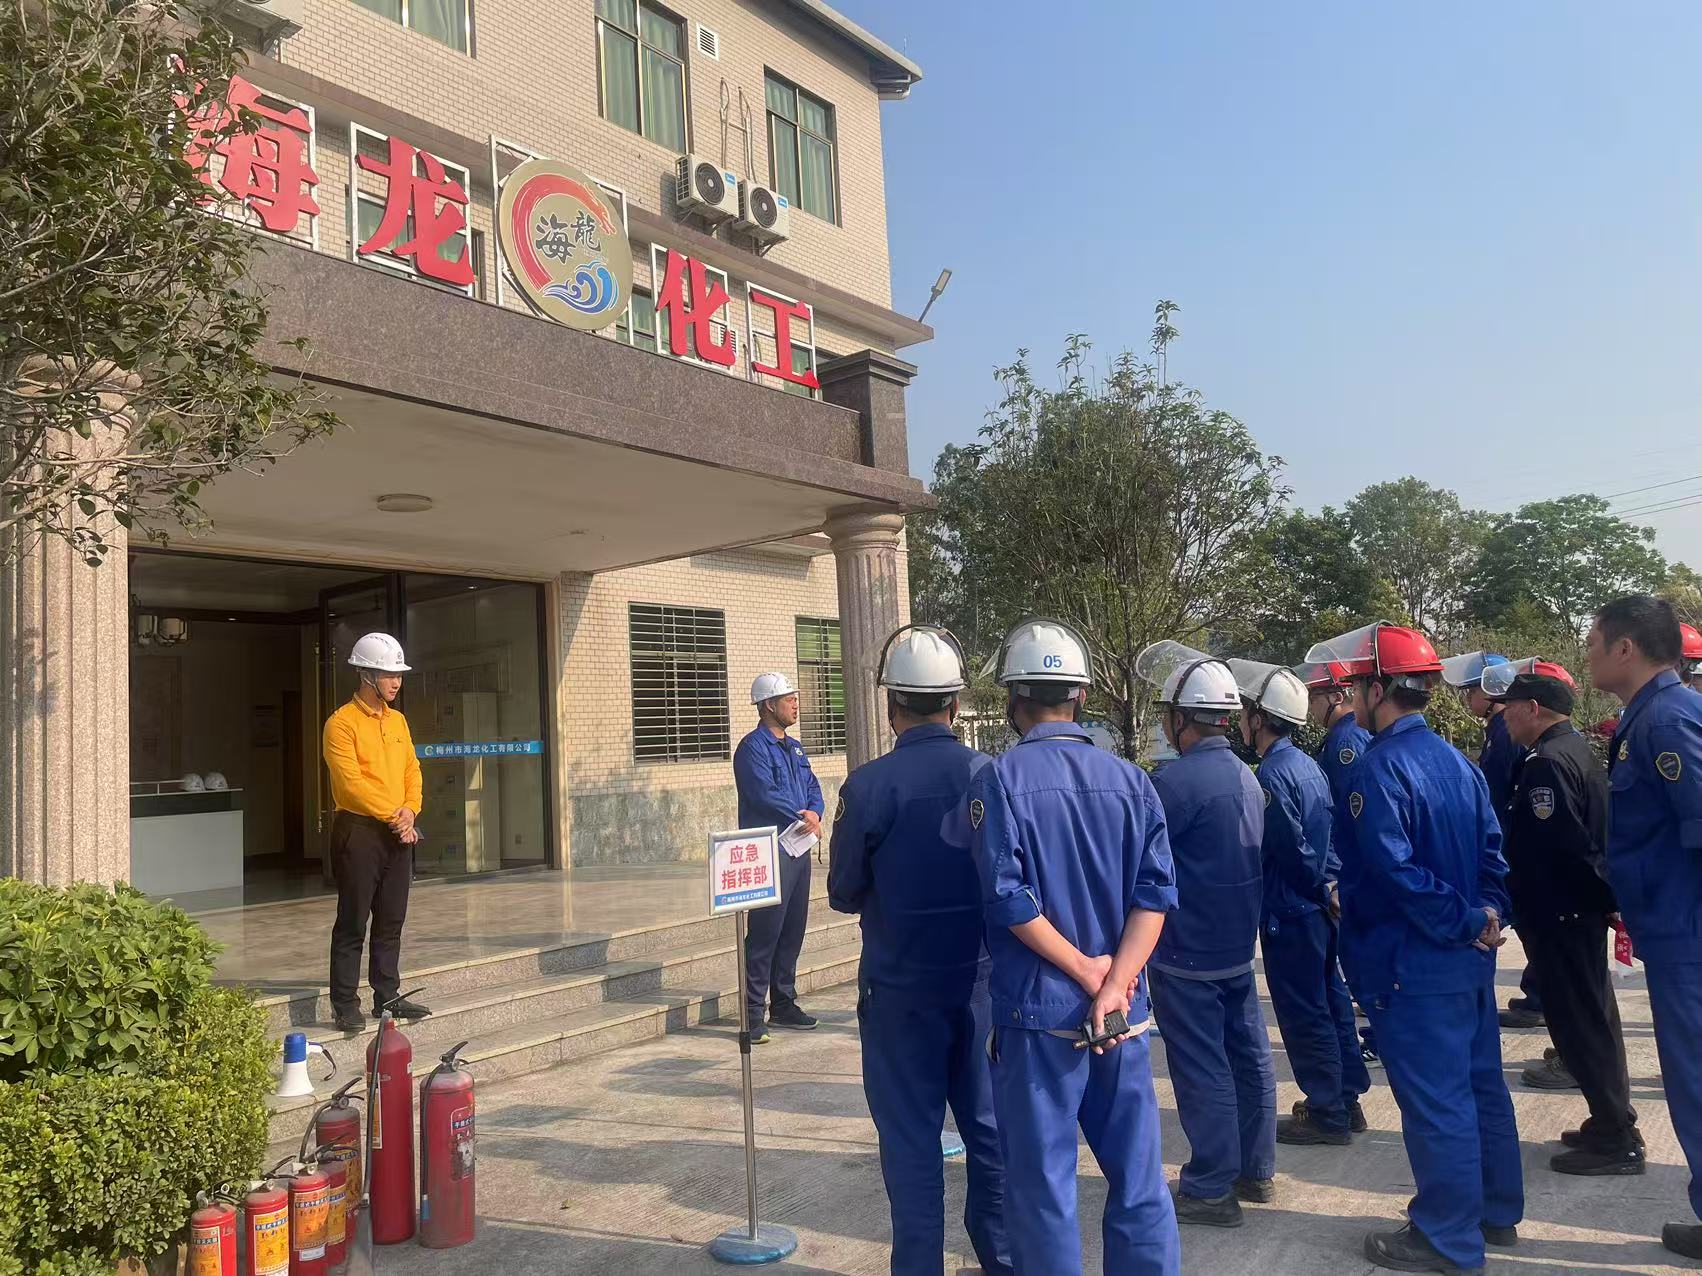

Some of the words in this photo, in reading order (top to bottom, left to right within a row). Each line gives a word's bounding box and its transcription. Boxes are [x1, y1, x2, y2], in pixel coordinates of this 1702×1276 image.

[656, 248, 820, 390] 化工
[1043, 655, 1063, 668] 05
[730, 843, 759, 864] 应急
[722, 865, 767, 890] 指挥部
